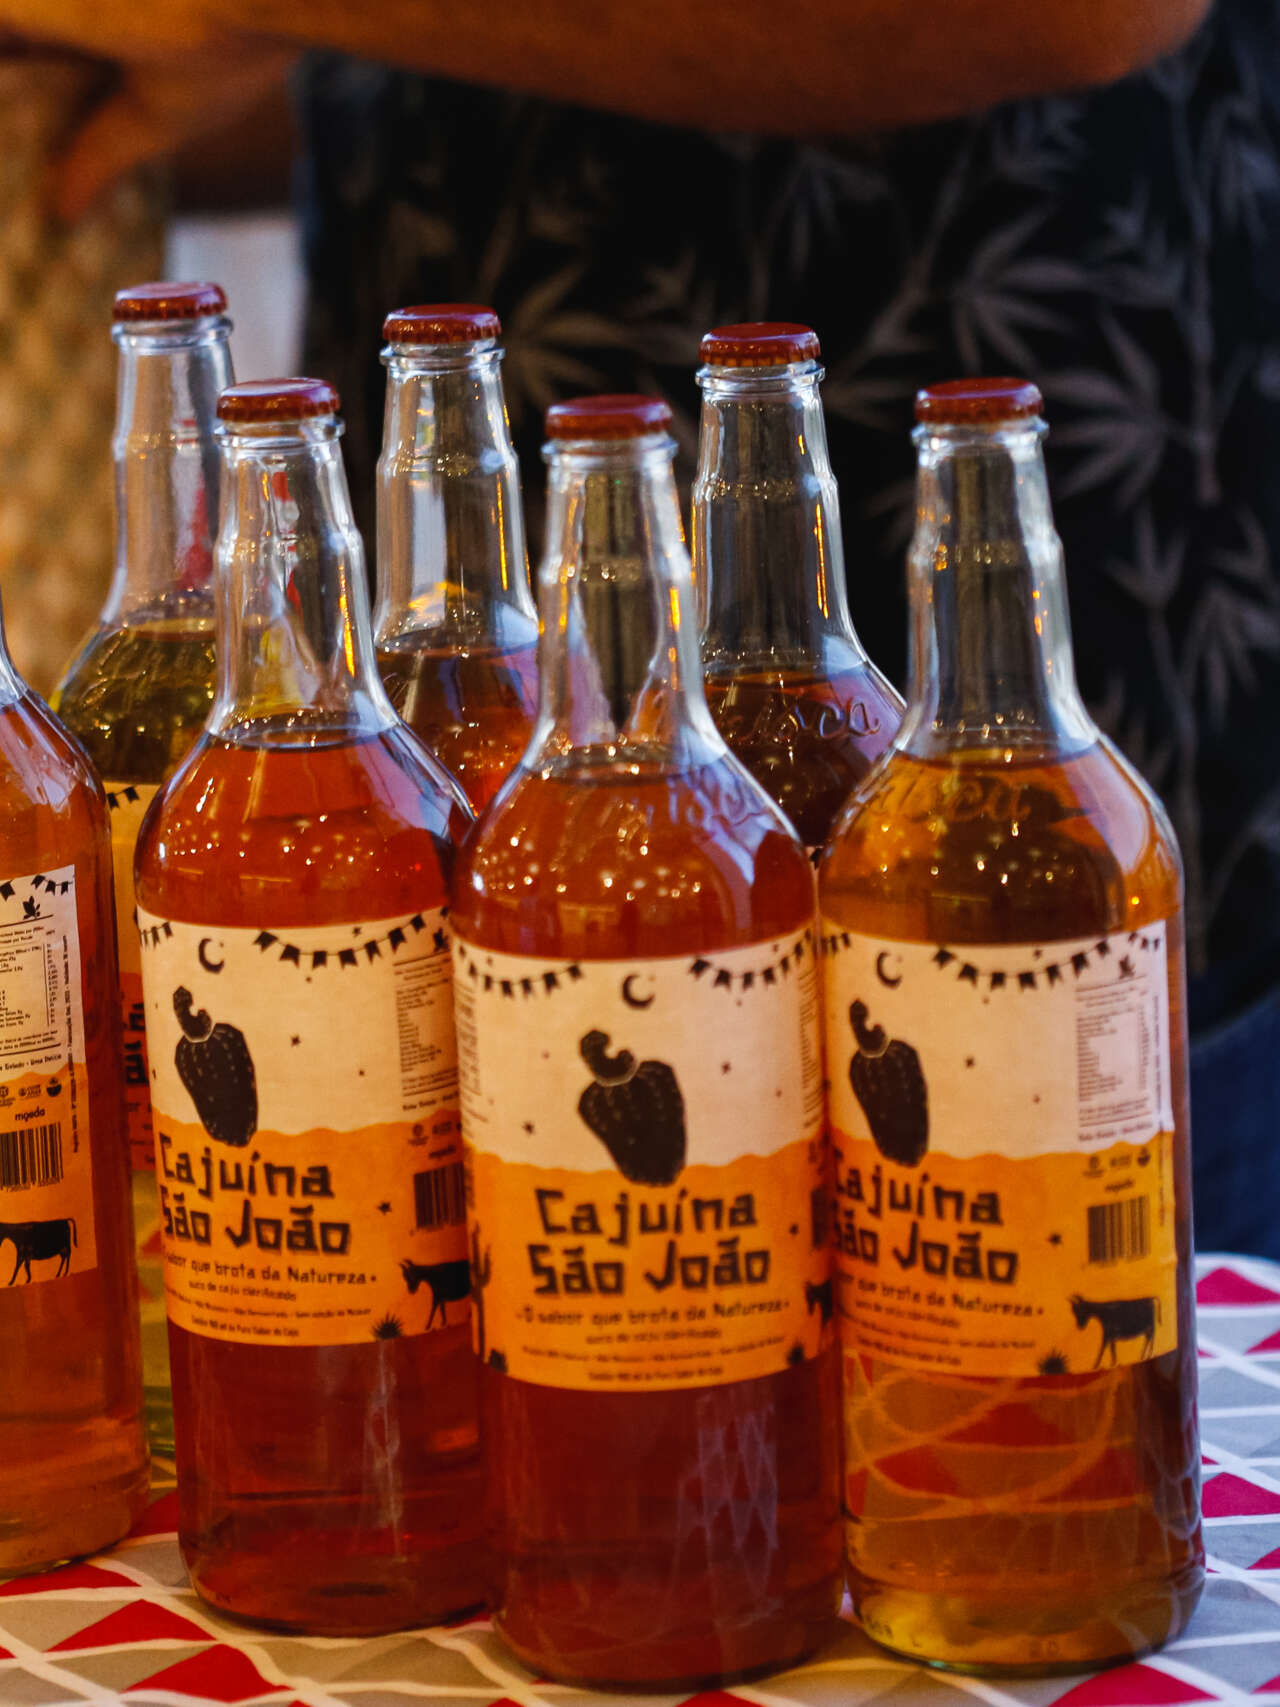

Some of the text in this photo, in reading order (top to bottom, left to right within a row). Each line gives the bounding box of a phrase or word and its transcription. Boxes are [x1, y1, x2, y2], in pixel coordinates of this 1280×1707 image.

[159, 1132, 335, 1201] Cajuína
[225, 1198, 350, 1255] João
[535, 1187, 758, 1247] Cajuína
[191, 1259, 211, 1275] que
[214, 1262, 255, 1279] brota
[261, 1266, 280, 1281] da
[287, 1267, 367, 1285] Natureza
[527, 1236, 770, 1297] São João
[892, 1220, 1018, 1286] João
[952, 1293, 1033, 1318] Natureza
